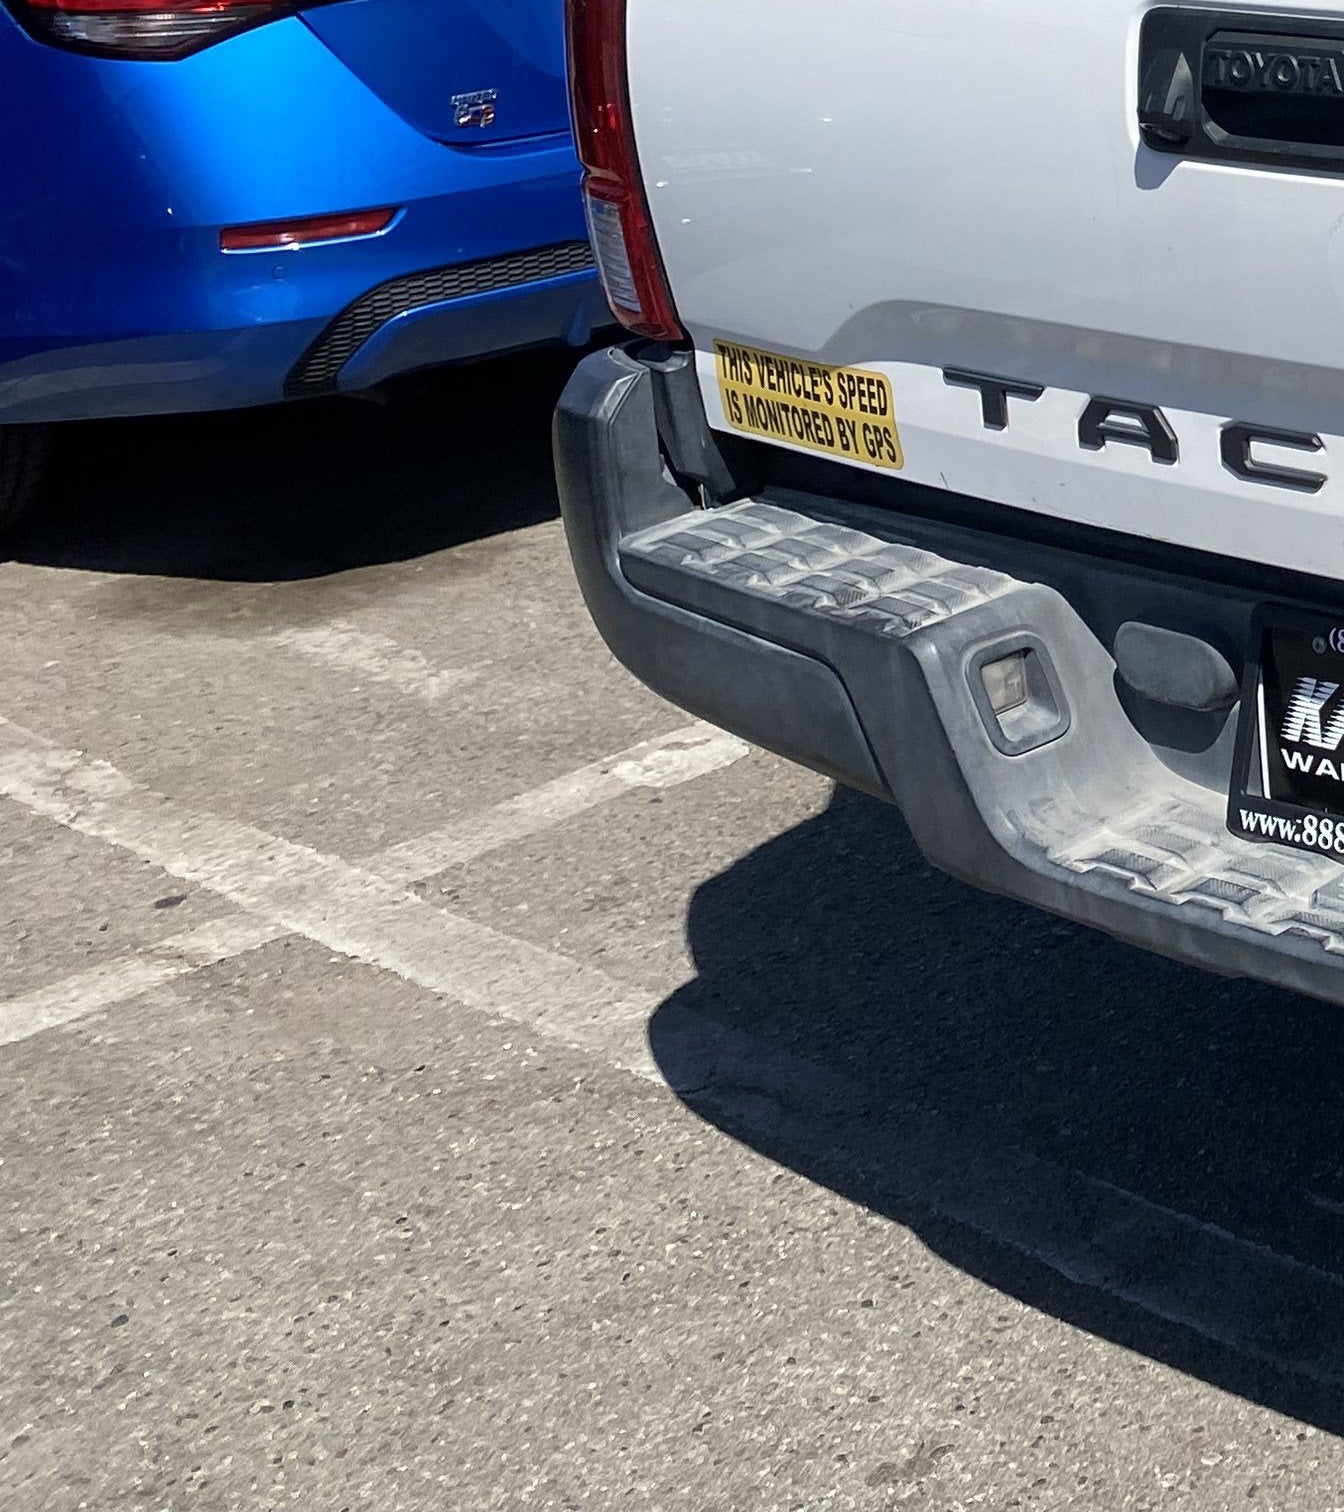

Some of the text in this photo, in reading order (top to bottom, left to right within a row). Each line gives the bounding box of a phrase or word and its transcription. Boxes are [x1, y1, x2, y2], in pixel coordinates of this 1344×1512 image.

[1208, 48, 1343, 92] TOYOTA
[716, 344, 887, 416] THIS VEHICLE'S SPEED
[725, 388, 897, 464] IS MONITORED BY GPS
